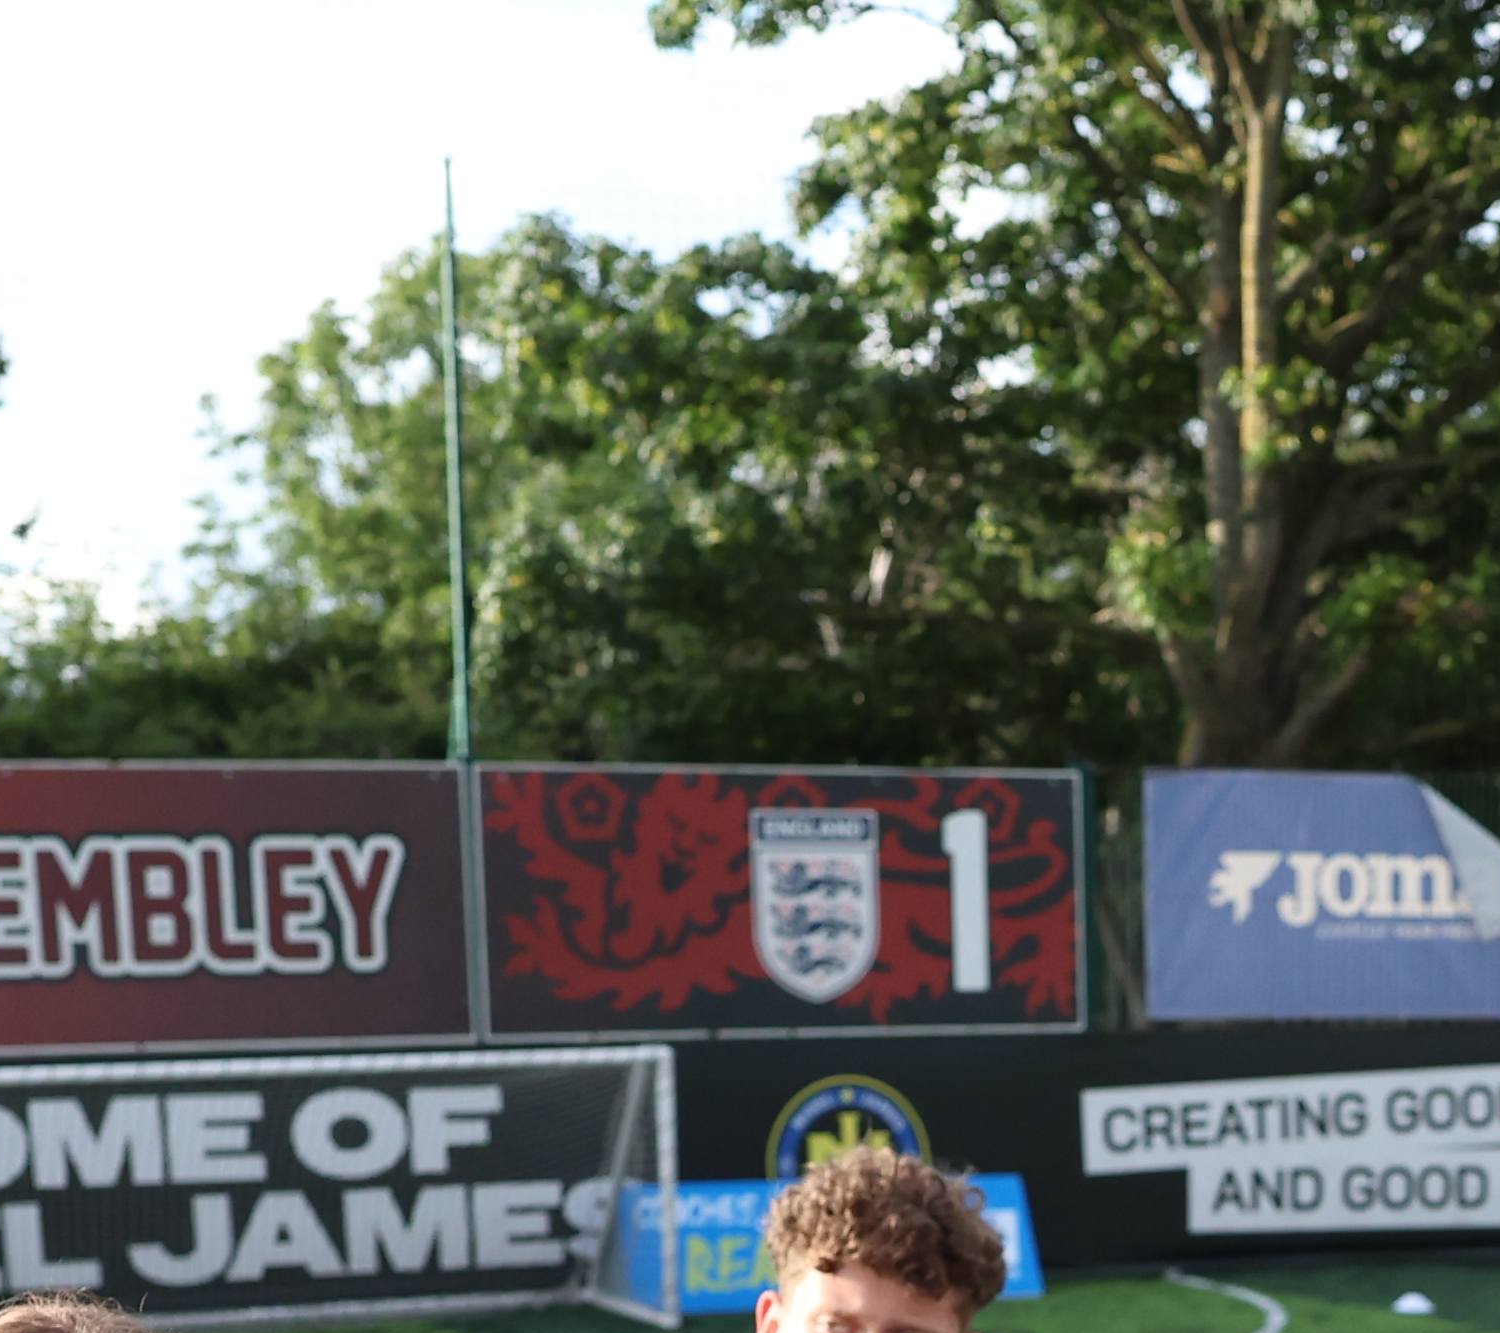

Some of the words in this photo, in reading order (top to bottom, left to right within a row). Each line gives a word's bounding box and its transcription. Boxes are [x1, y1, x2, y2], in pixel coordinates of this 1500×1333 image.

[941, 808, 992, 993] 1
[288, 1084, 504, 1181] OF
[1101, 1092, 1370, 1154] CREATING
[1211, 1166, 1325, 1216] AND
[1342, 1163, 1490, 1214] GOOD
